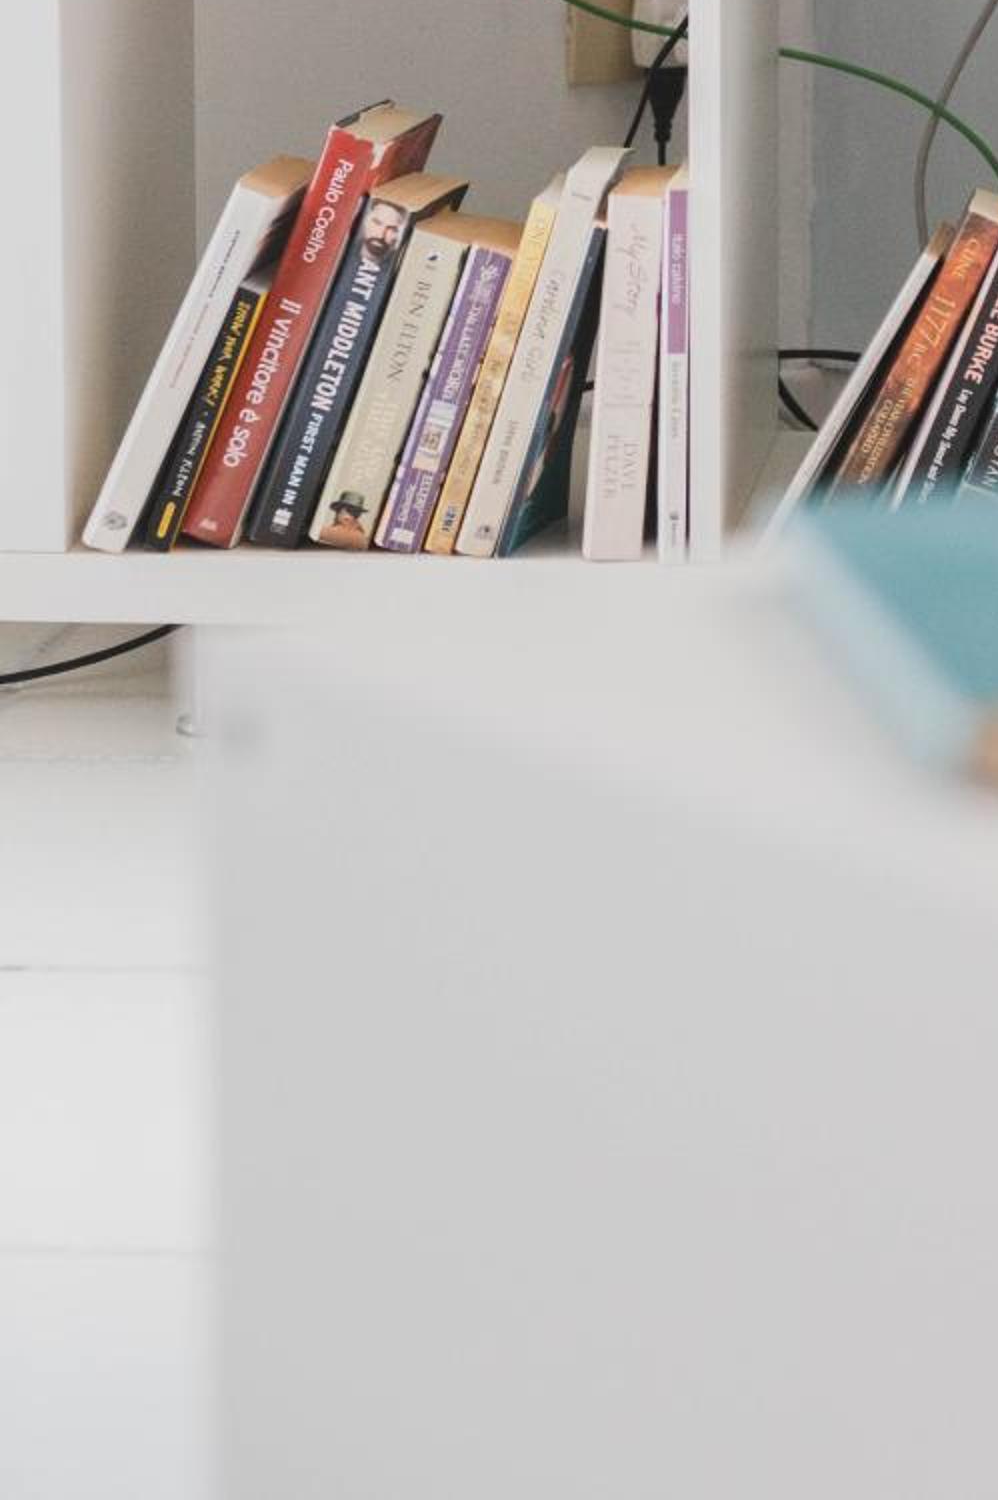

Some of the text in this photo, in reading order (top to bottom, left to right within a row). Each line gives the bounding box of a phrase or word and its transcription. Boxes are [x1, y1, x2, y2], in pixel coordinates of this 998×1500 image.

[300, 158, 353, 265] Paulo Coelho
[309, 257, 381, 413] ANT MIDDLETON
[405, 278, 433, 318] BEN
[914, 293, 957, 348] 1177
[221, 296, 302, 469] Il vincitore è solo
[280, 411, 323, 505] FIRST MAN IN
